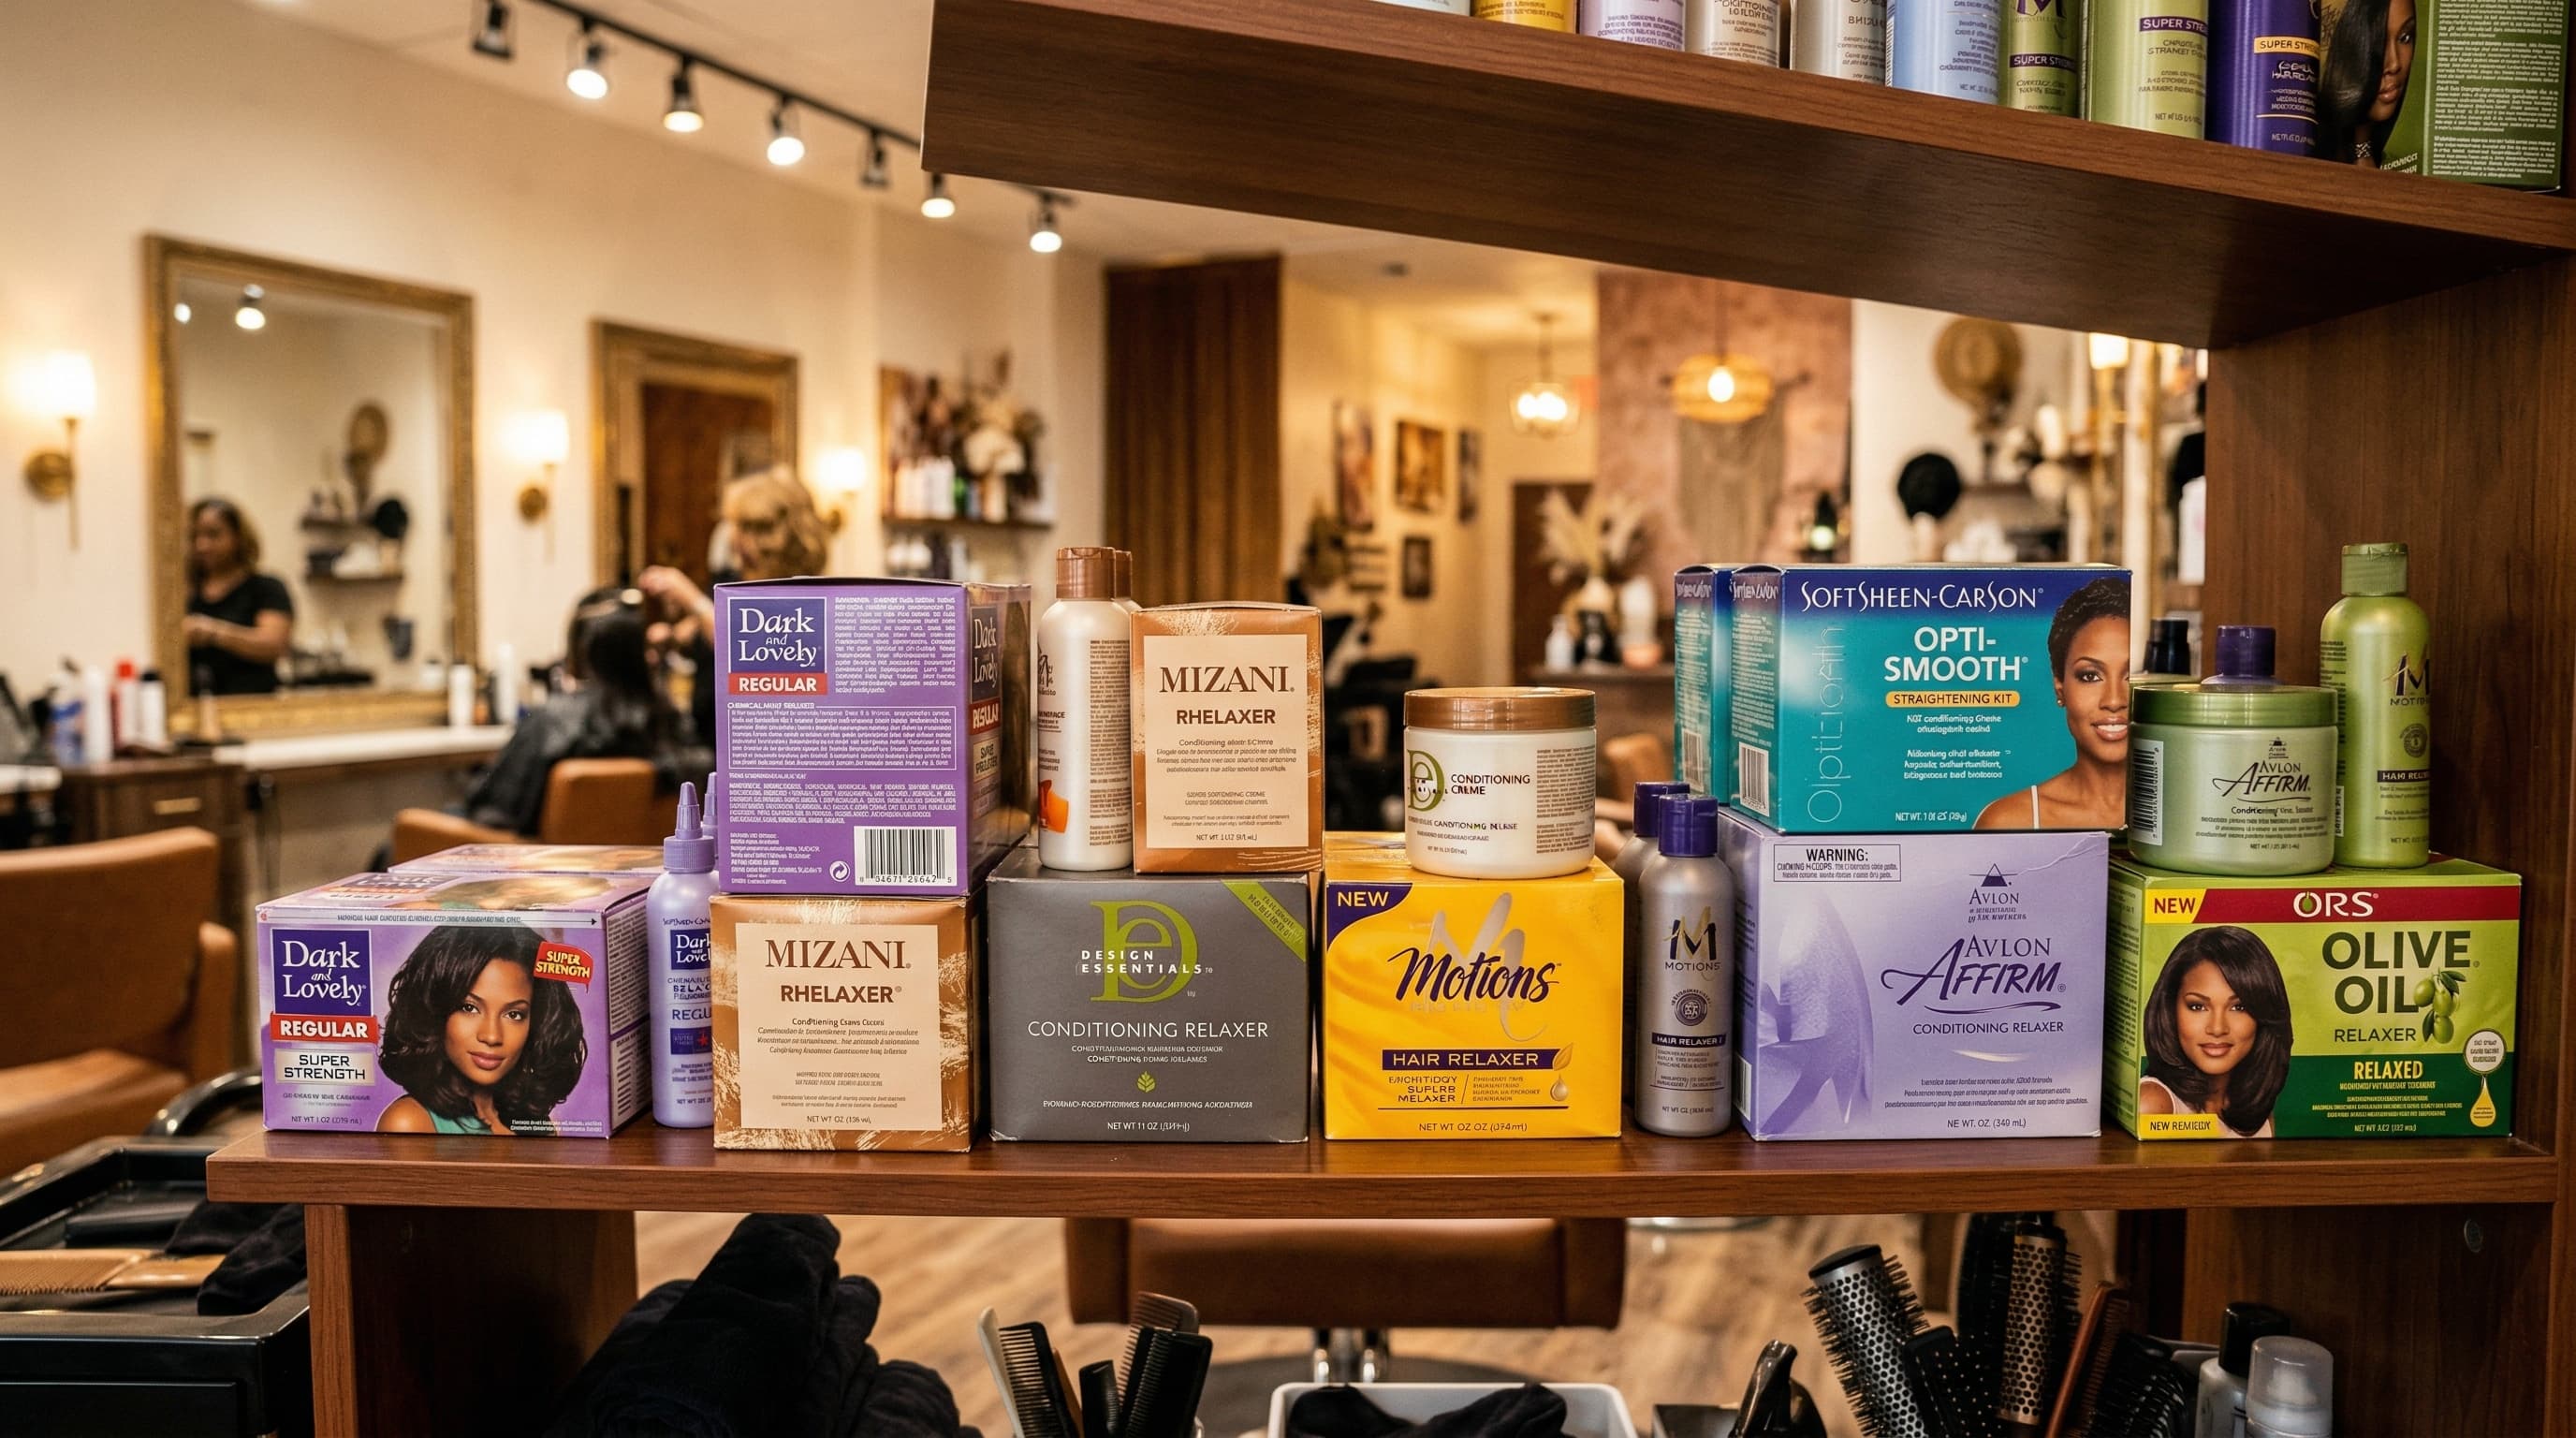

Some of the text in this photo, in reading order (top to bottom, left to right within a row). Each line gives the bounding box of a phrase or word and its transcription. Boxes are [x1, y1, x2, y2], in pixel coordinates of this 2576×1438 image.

[2143, 19, 2183, 29] SUPER
[2260, 40, 2292, 50] SUPER
[2014, 56, 2048, 66] SUPER
[739, 608, 815, 634] Dark
[1914, 626, 1997, 653] OPTI-
[739, 639, 817, 668] Lovely
[1883, 656, 2021, 682] SMOOTH
[739, 678, 817, 693] REGULAR
[1159, 666, 1289, 693] MIZANI
[1894, 694, 2012, 704] STRAIGHTENING KIT
[1177, 710, 1276, 725] RHELAXER
[2259, 760, 2301, 773] AVLON
[1451, 774, 1530, 785] CONDITIONING
[2212, 762, 2309, 797] AFFIRM
[1807, 848, 1868, 861] WARNING:
[1338, 891, 1389, 906] NEW
[1969, 888, 2019, 904] AVLON
[2293, 891, 2374, 917] ORS
[2154, 898, 2195, 914] NEW
[765, 939, 906, 969] MIZANI
[1965, 934, 2051, 958] AVLON
[2322, 931, 2471, 970] OLIVE
[282, 940, 360, 969] Dark
[547, 951, 580, 965] SUPER
[1081, 950, 1154, 960] DESIGN
[312, 968, 331, 981] and
[535, 961, 591, 978] STRENGTH
[1081, 964, 1202, 974] ESSENTIALS
[1387, 947, 1559, 1003] Motions
[1881, 938, 2062, 1005] AFFIRM
[283, 974, 362, 1005] Lovely
[781, 985, 894, 1004] RHELAXER
[2334, 976, 2420, 1014] OIL
[672, 1007, 711, 1020] REGU
[281, 1016, 368, 1038] REGULAR
[1028, 1021, 1268, 1038] CONDITIONING RELAXER
[1913, 1021, 2064, 1034] CONDITIONING RELAXER
[2334, 1028, 2417, 1042] RELAXER
[300, 1055, 350, 1066] SUPER
[1393, 1053, 1539, 1065] HAIR RELAXER
[285, 1067, 365, 1079] STRENGTH
[2354, 1061, 2423, 1079] RELAXED
[2150, 1121, 2170, 1131] NEW
